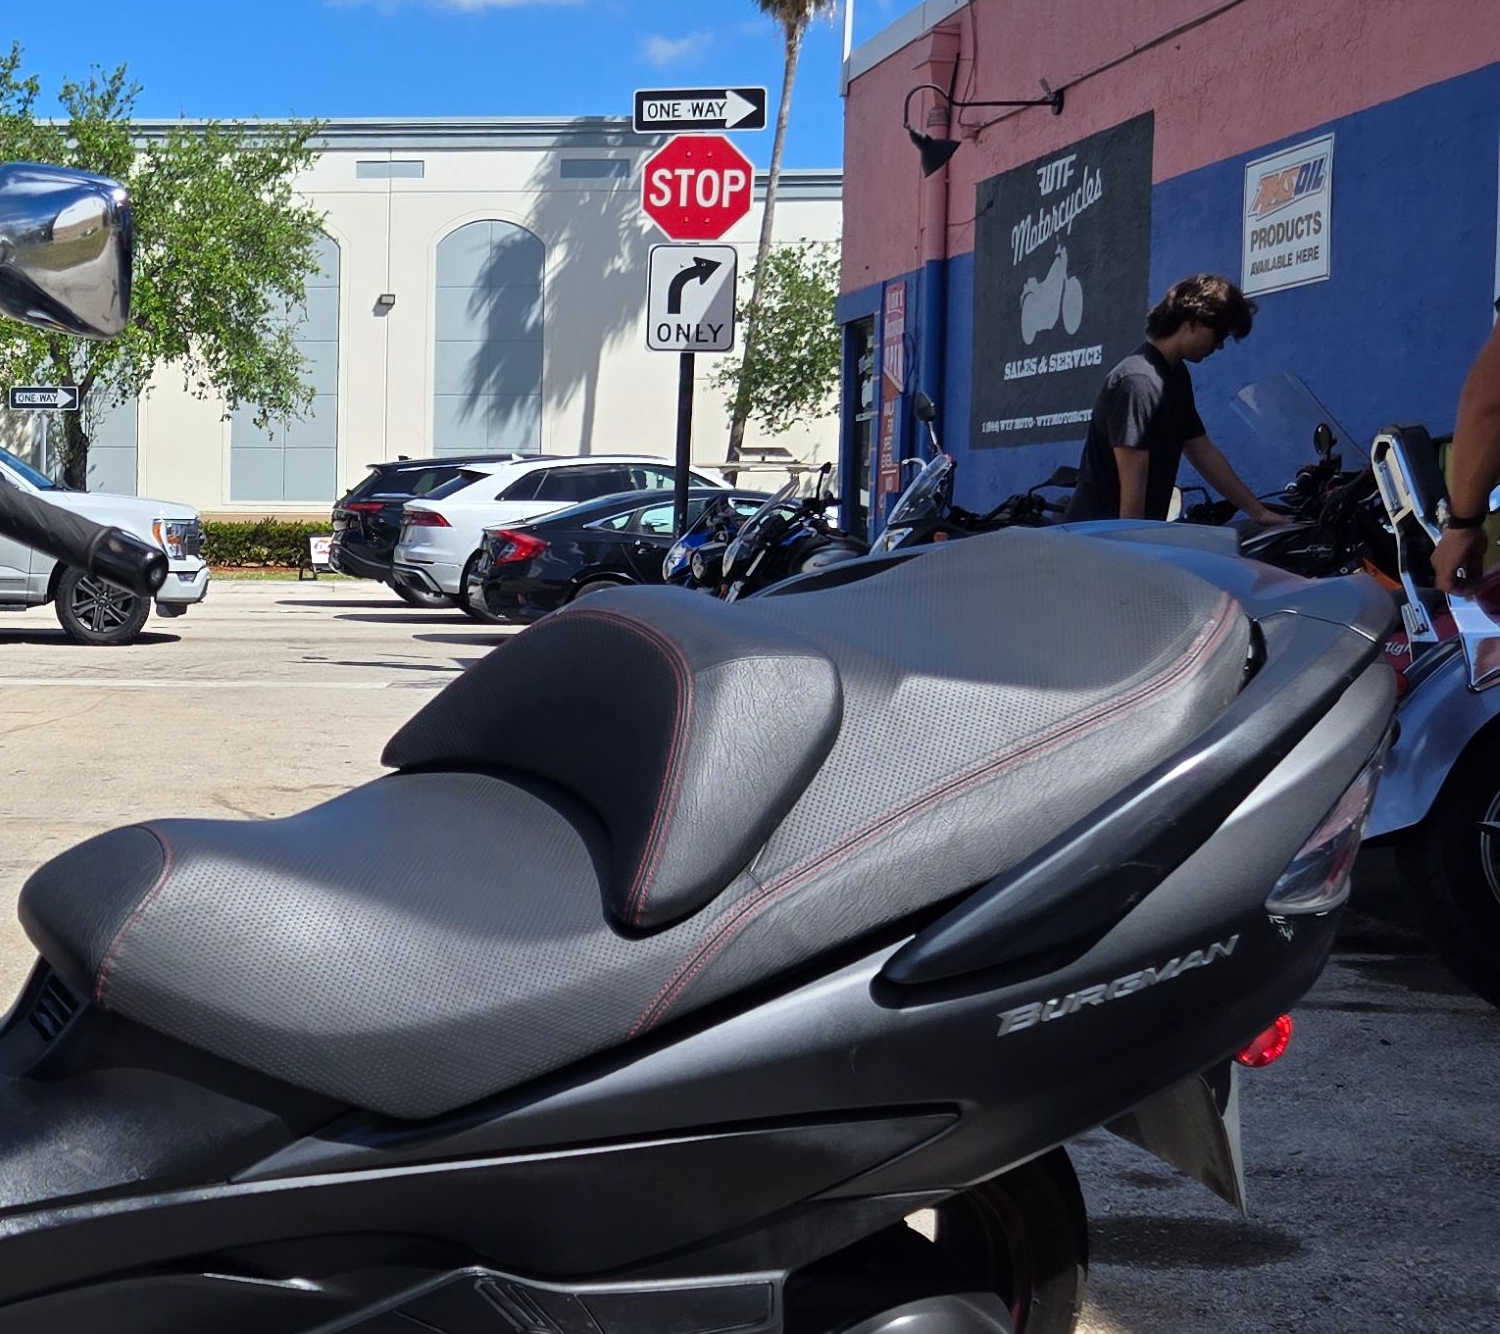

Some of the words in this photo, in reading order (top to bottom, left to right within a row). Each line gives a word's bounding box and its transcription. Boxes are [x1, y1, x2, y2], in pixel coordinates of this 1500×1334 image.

[647, 103, 682, 118] ONE
[690, 100, 727, 117] WAY
[649, 168, 746, 208] STOP
[1037, 154, 1077, 196] WTF
[1251, 157, 1325, 216] AMSOIL
[1011, 165, 1102, 266] Motorcycles
[1250, 210, 1322, 252] PRODUCTS
[1250, 252, 1293, 276] AVAILABLE
[1295, 245, 1320, 265] HERE
[656, 323, 725, 343] ONLY
[1003, 357, 1038, 381] SALES
[1038, 356, 1048, 374] &
[1048, 345, 1103, 372] SERVICE
[18, 394, 36, 402] ONE
[39, 394, 58, 402] WAY
[996, 934, 1240, 1037] BURGMAN
